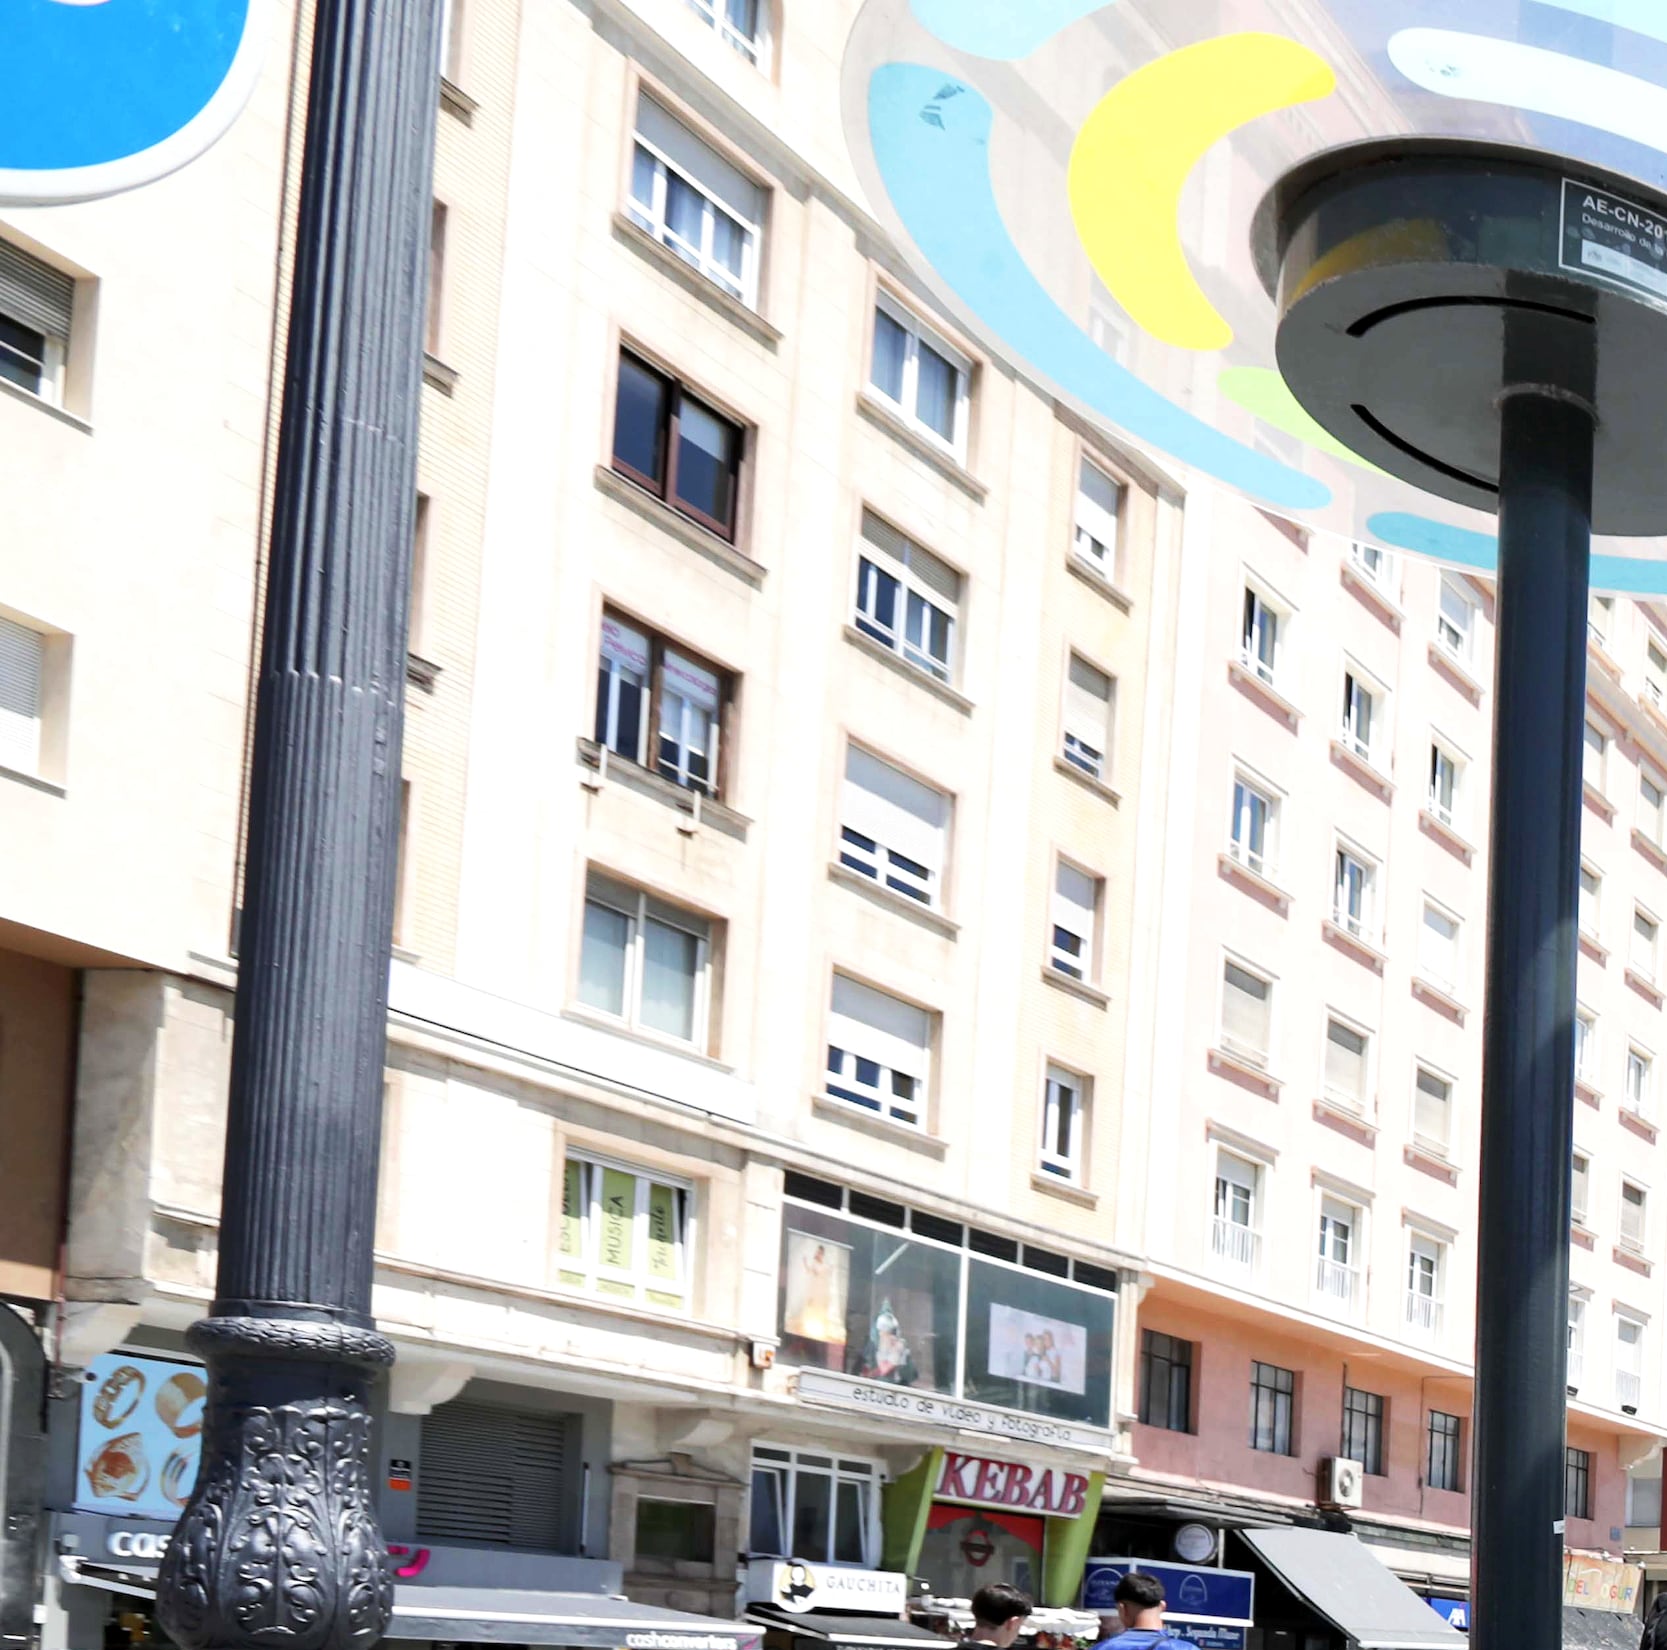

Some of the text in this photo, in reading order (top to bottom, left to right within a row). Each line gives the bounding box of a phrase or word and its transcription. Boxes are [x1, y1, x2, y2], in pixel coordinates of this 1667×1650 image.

[1581, 213, 1637, 242] Desarrollo
[852, 1386, 909, 1410] estudio
[915, 1400, 935, 1414] de
[986, 1414, 996, 1430] y
[934, 1452, 1088, 1516] KEBAB
[825, 1574, 901, 1595] GAUCHITA
[1592, 1582, 1634, 1601] OGUR
